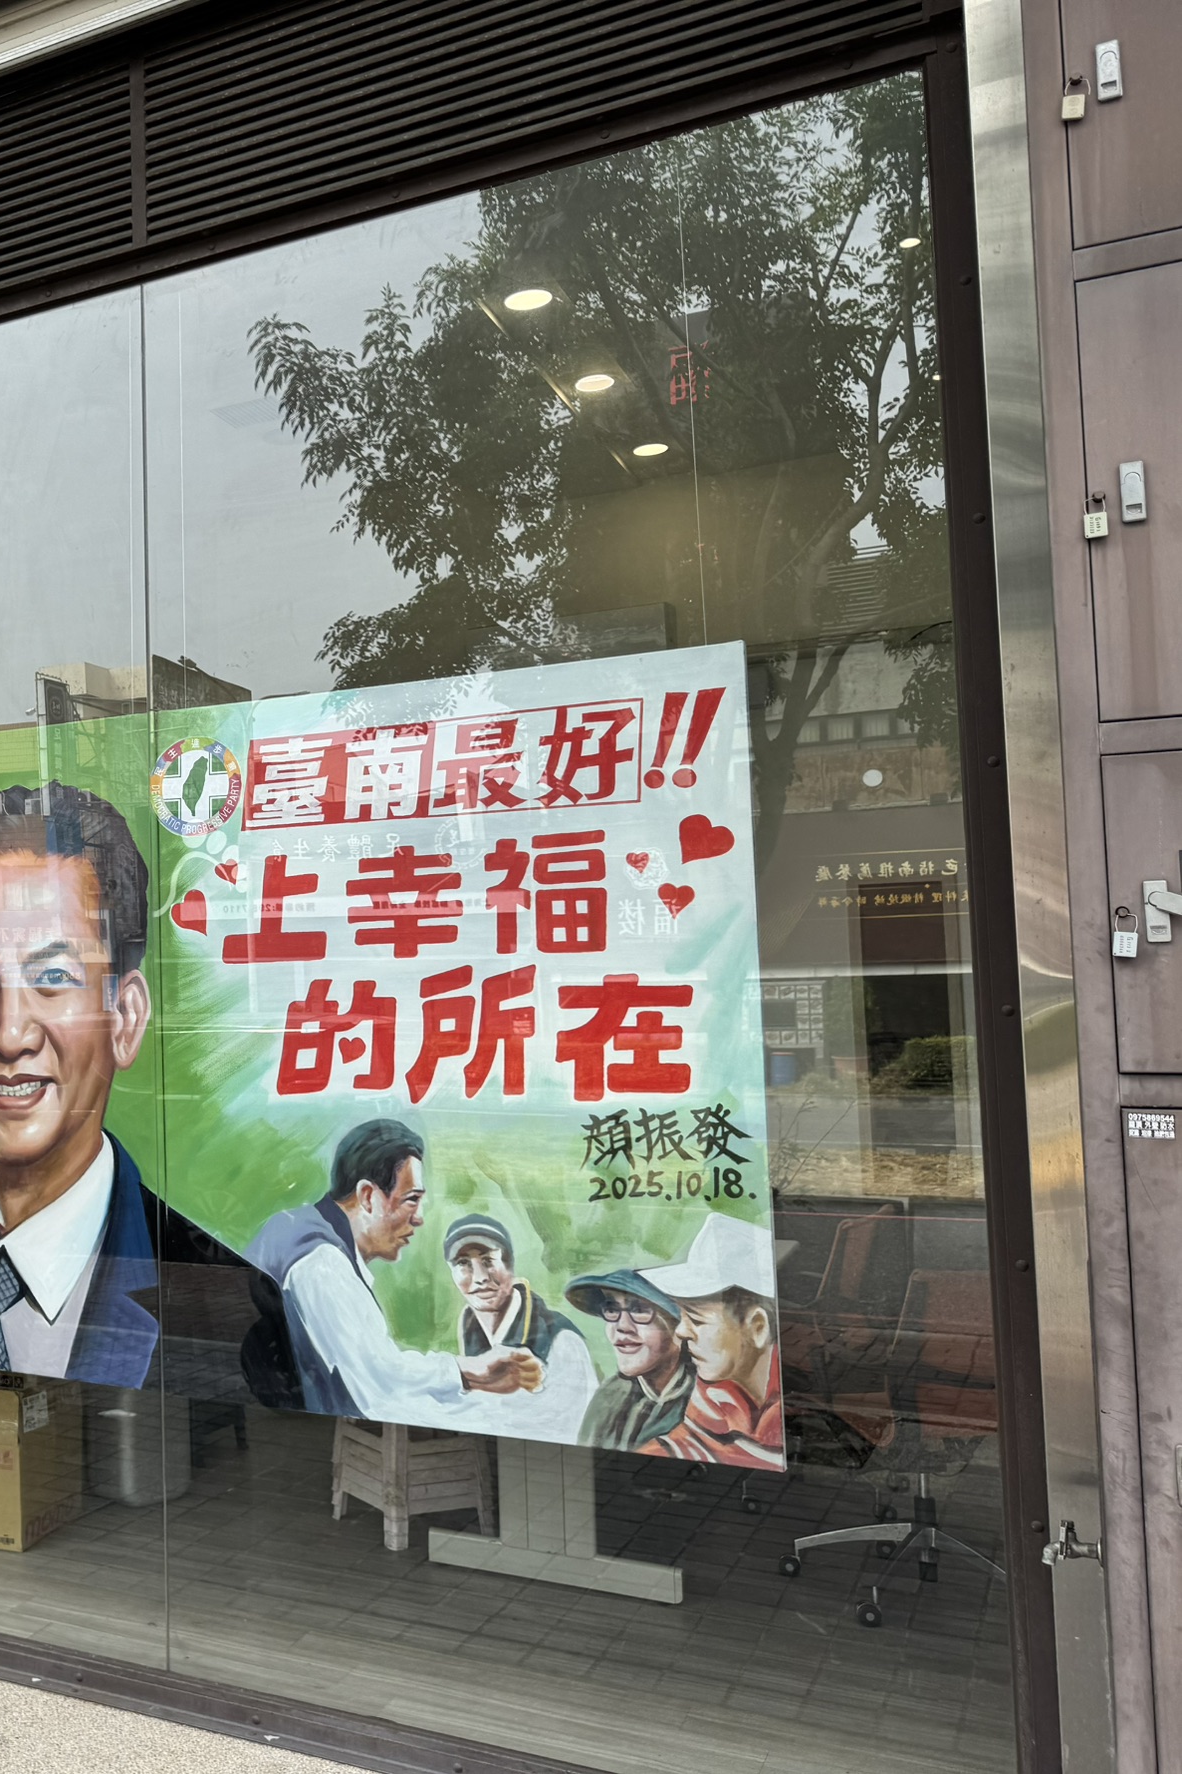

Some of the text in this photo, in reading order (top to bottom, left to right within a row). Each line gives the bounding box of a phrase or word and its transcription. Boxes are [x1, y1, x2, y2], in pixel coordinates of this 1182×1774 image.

[151, 778, 240, 835] DEMOCRATIC PROGRESSIVE PARTY
[222, 830, 607, 964] 上幸福
[276, 964, 694, 1104] 的所在
[587, 1167, 758, 1203] 2025.10.18.
